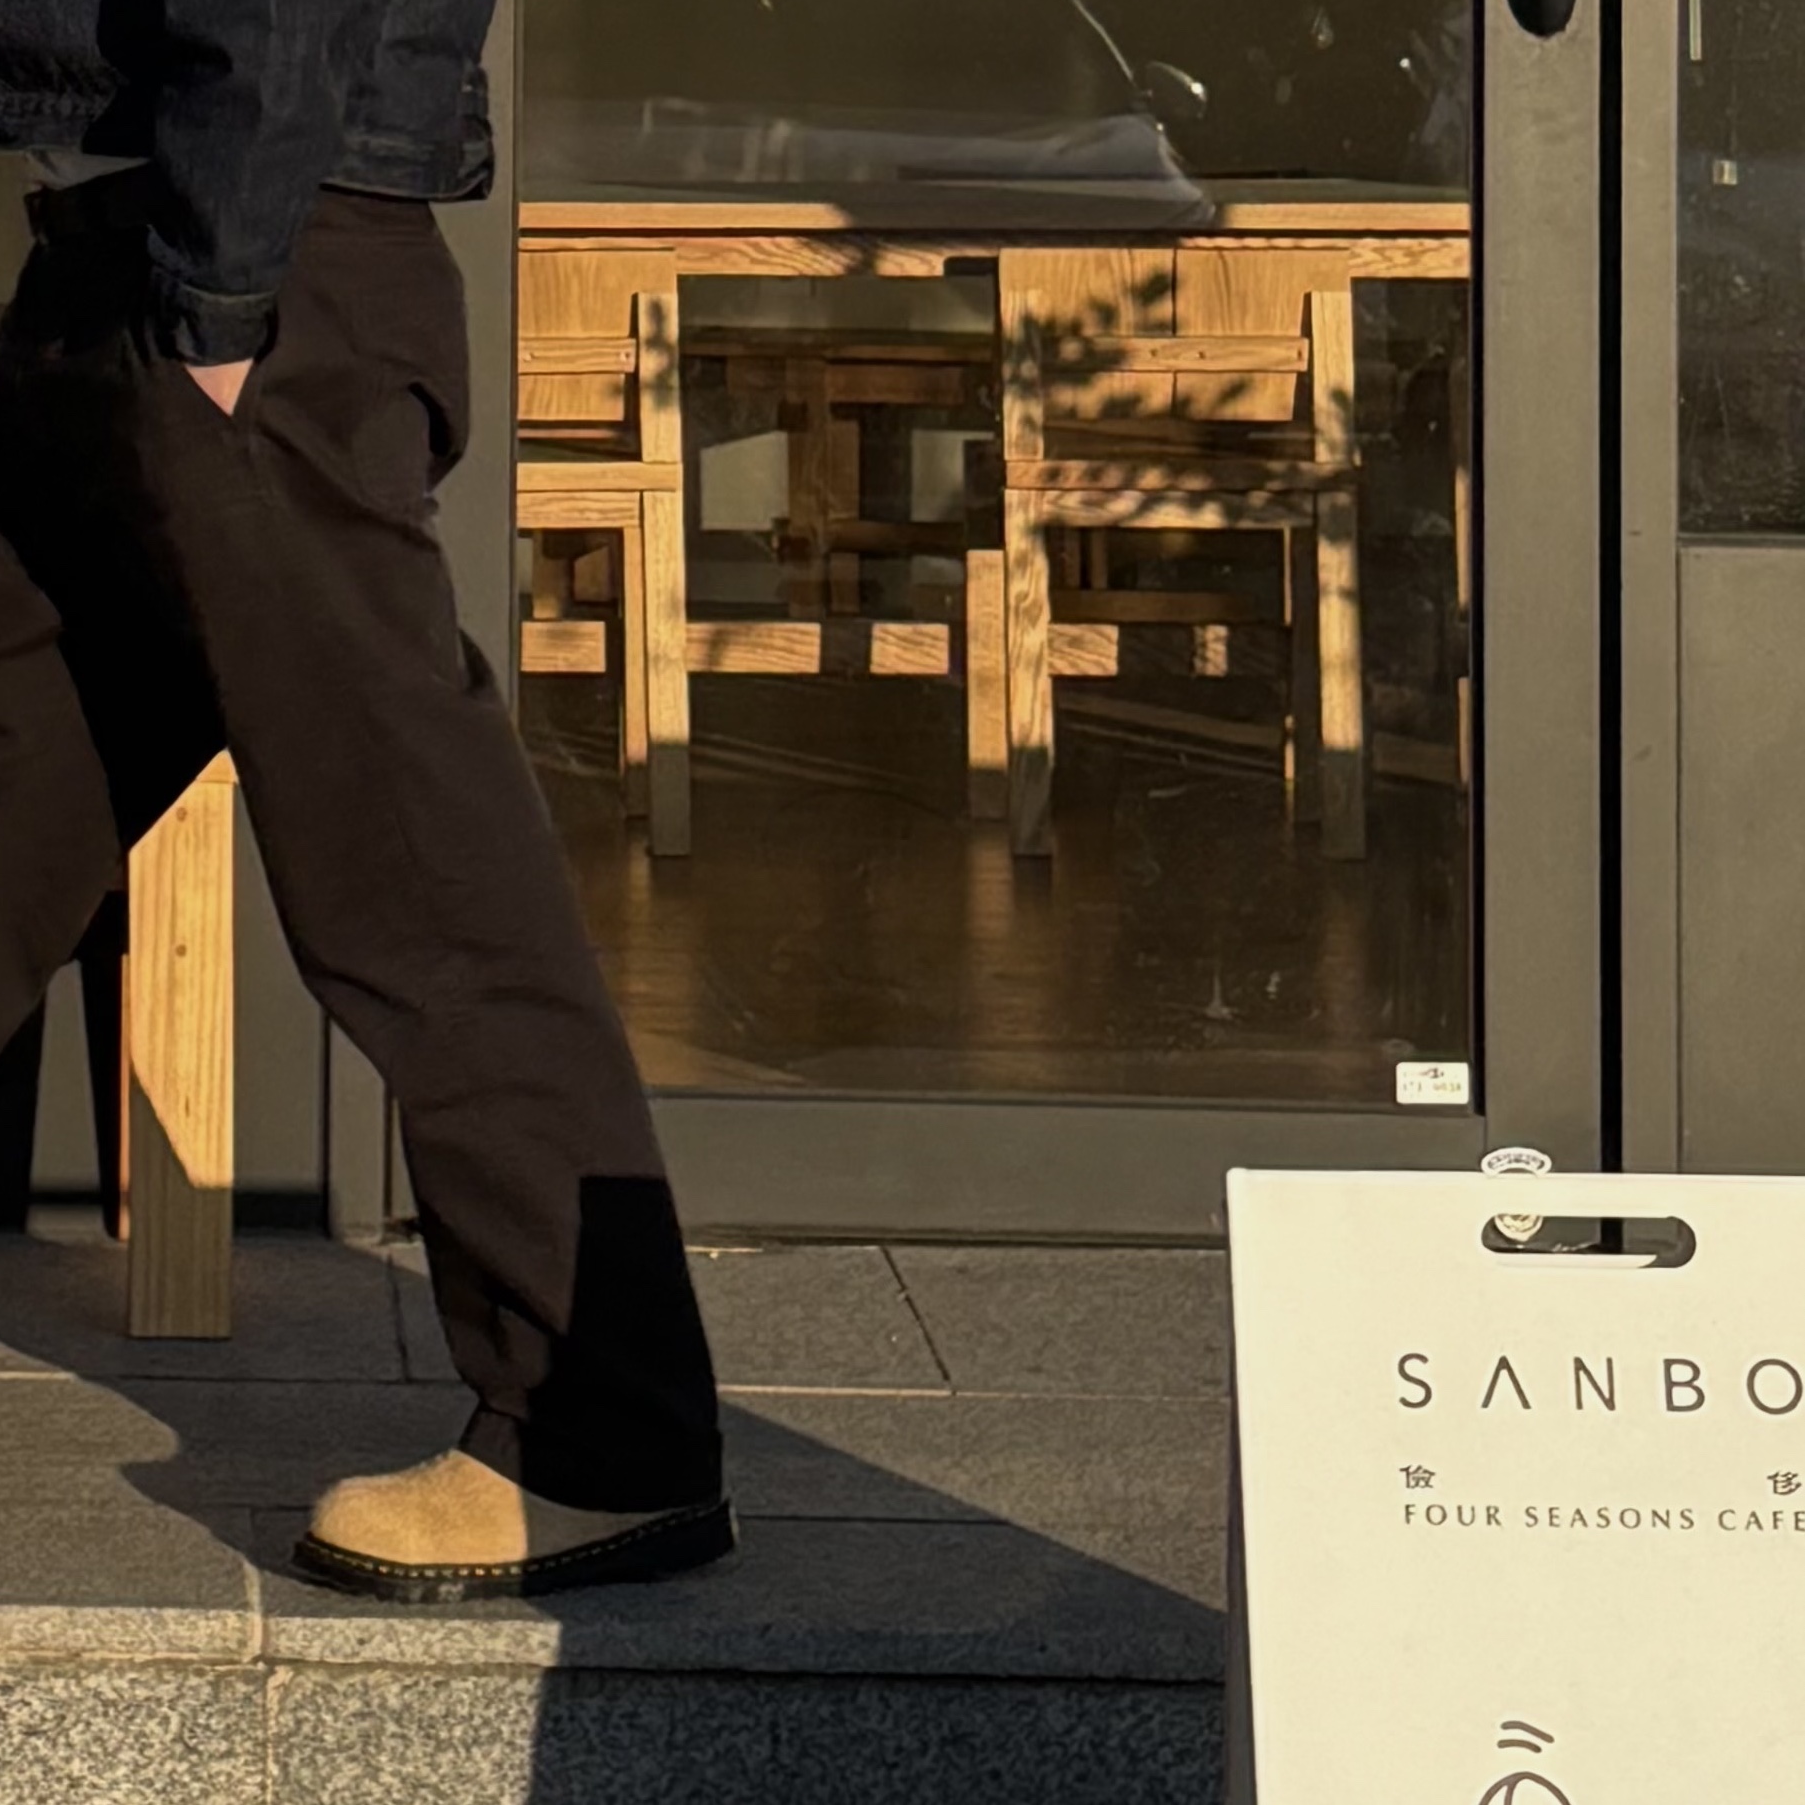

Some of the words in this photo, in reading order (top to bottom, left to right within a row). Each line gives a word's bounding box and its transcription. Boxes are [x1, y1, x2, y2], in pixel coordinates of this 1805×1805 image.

[1397, 1352, 1804, 1416] SANBO
[1404, 1504, 1501, 1528] FOUR
[1525, 1505, 1696, 1532] SEASONS
[1717, 1508, 1805, 1532] CAFE
